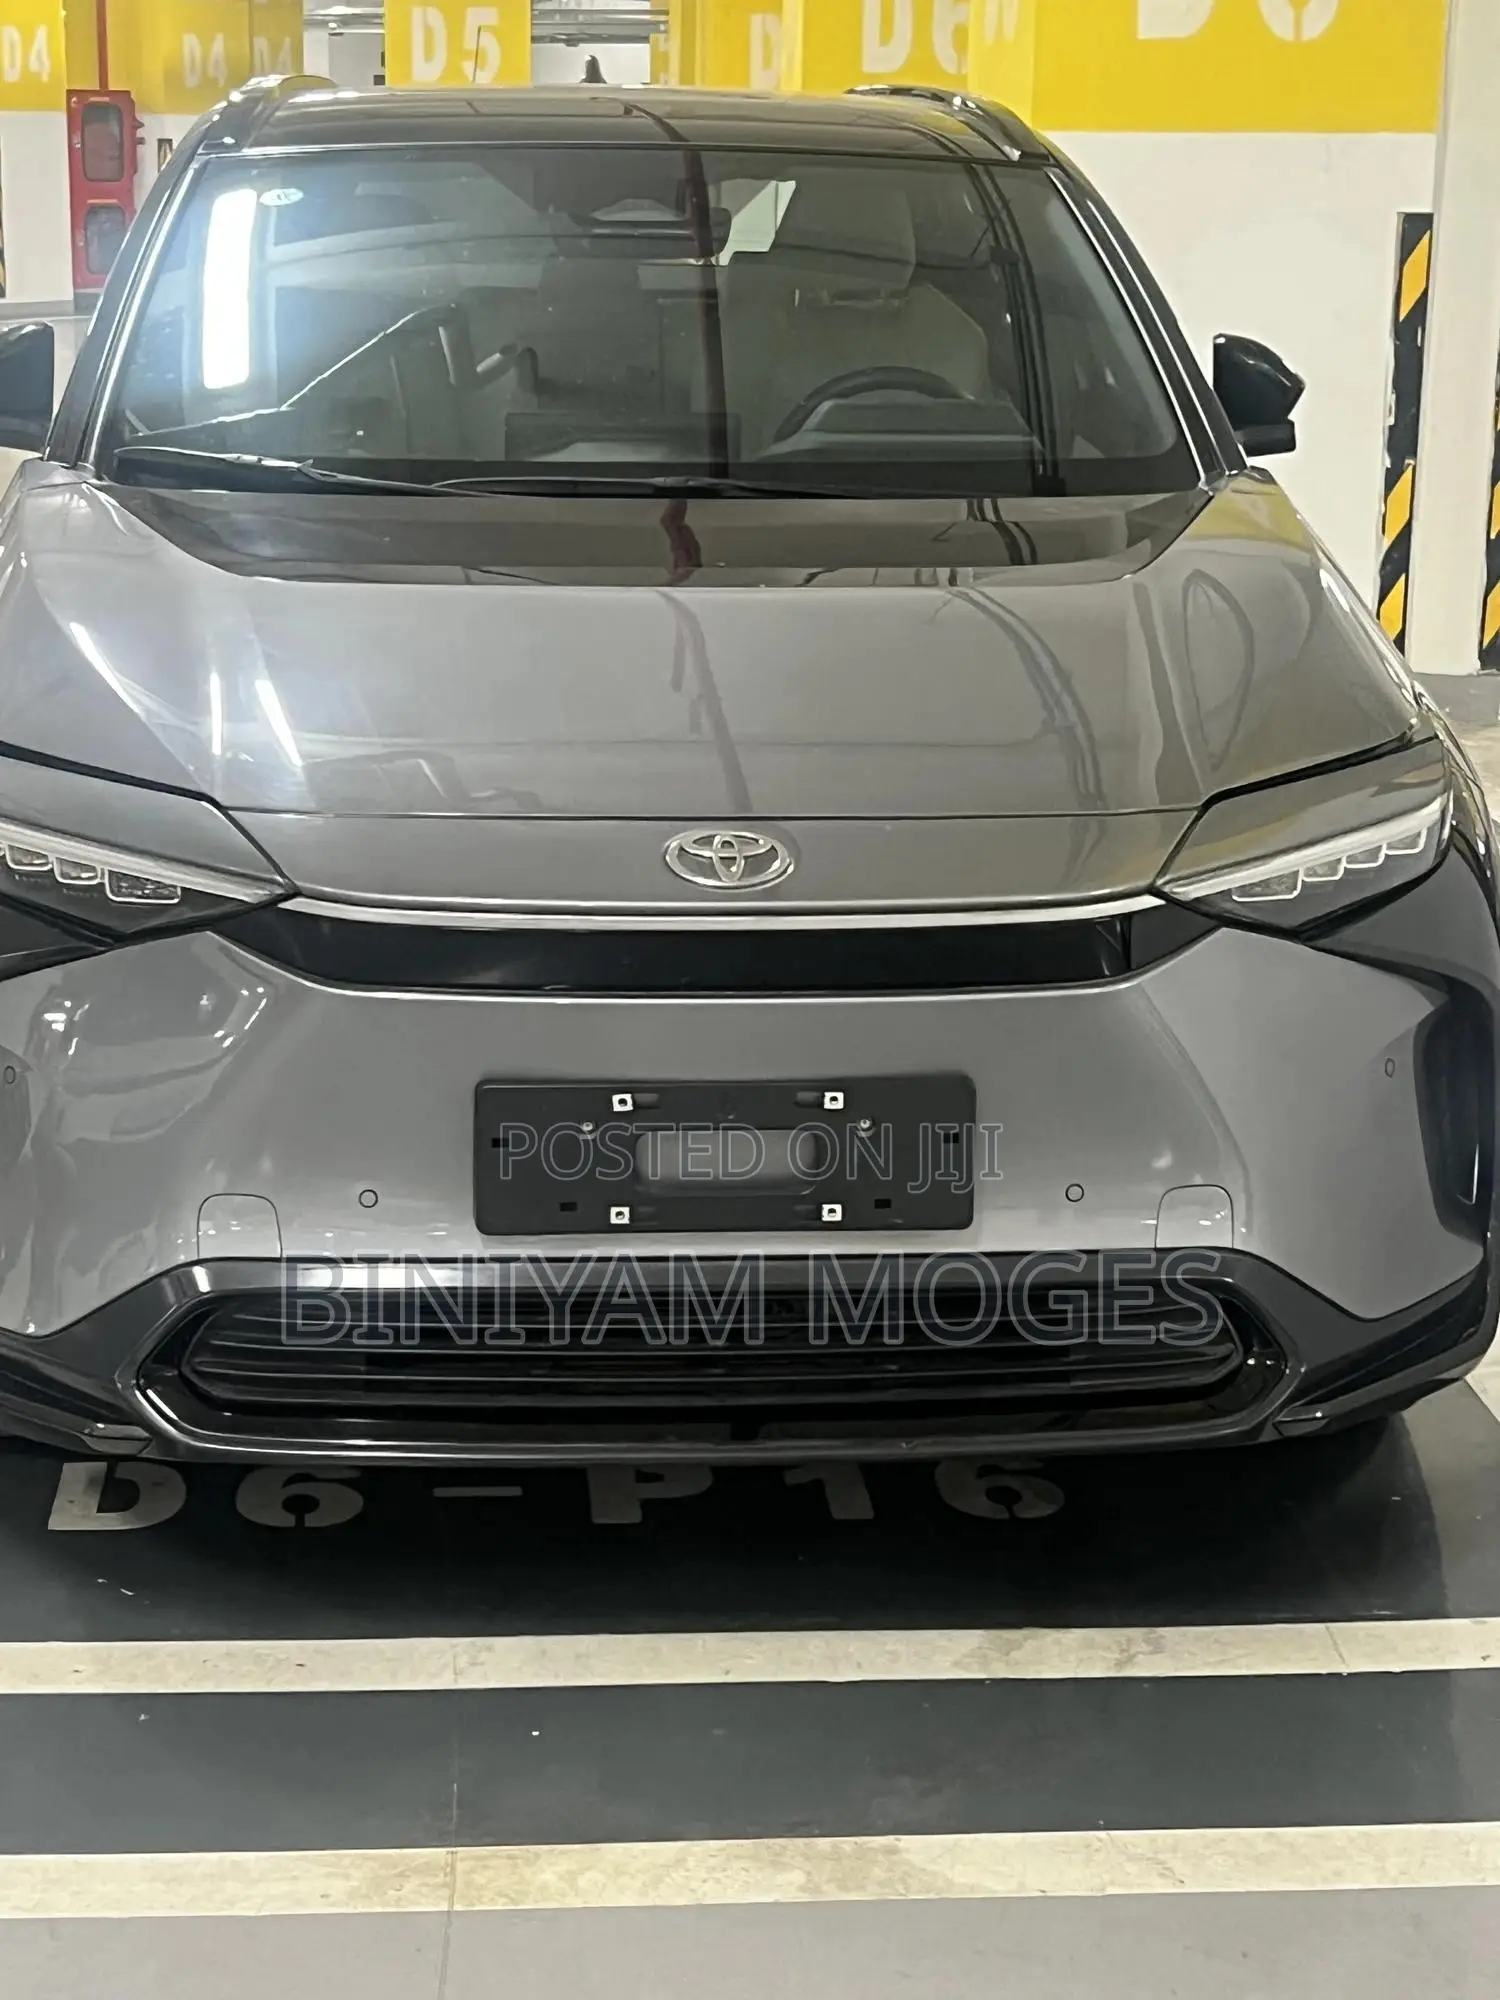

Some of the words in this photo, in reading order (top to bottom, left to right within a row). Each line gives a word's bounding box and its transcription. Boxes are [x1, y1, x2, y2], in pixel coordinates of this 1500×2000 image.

[1, 24, 50, 82] D4
[182, 32, 228, 88] D4
[411, 6, 502, 84] D5
